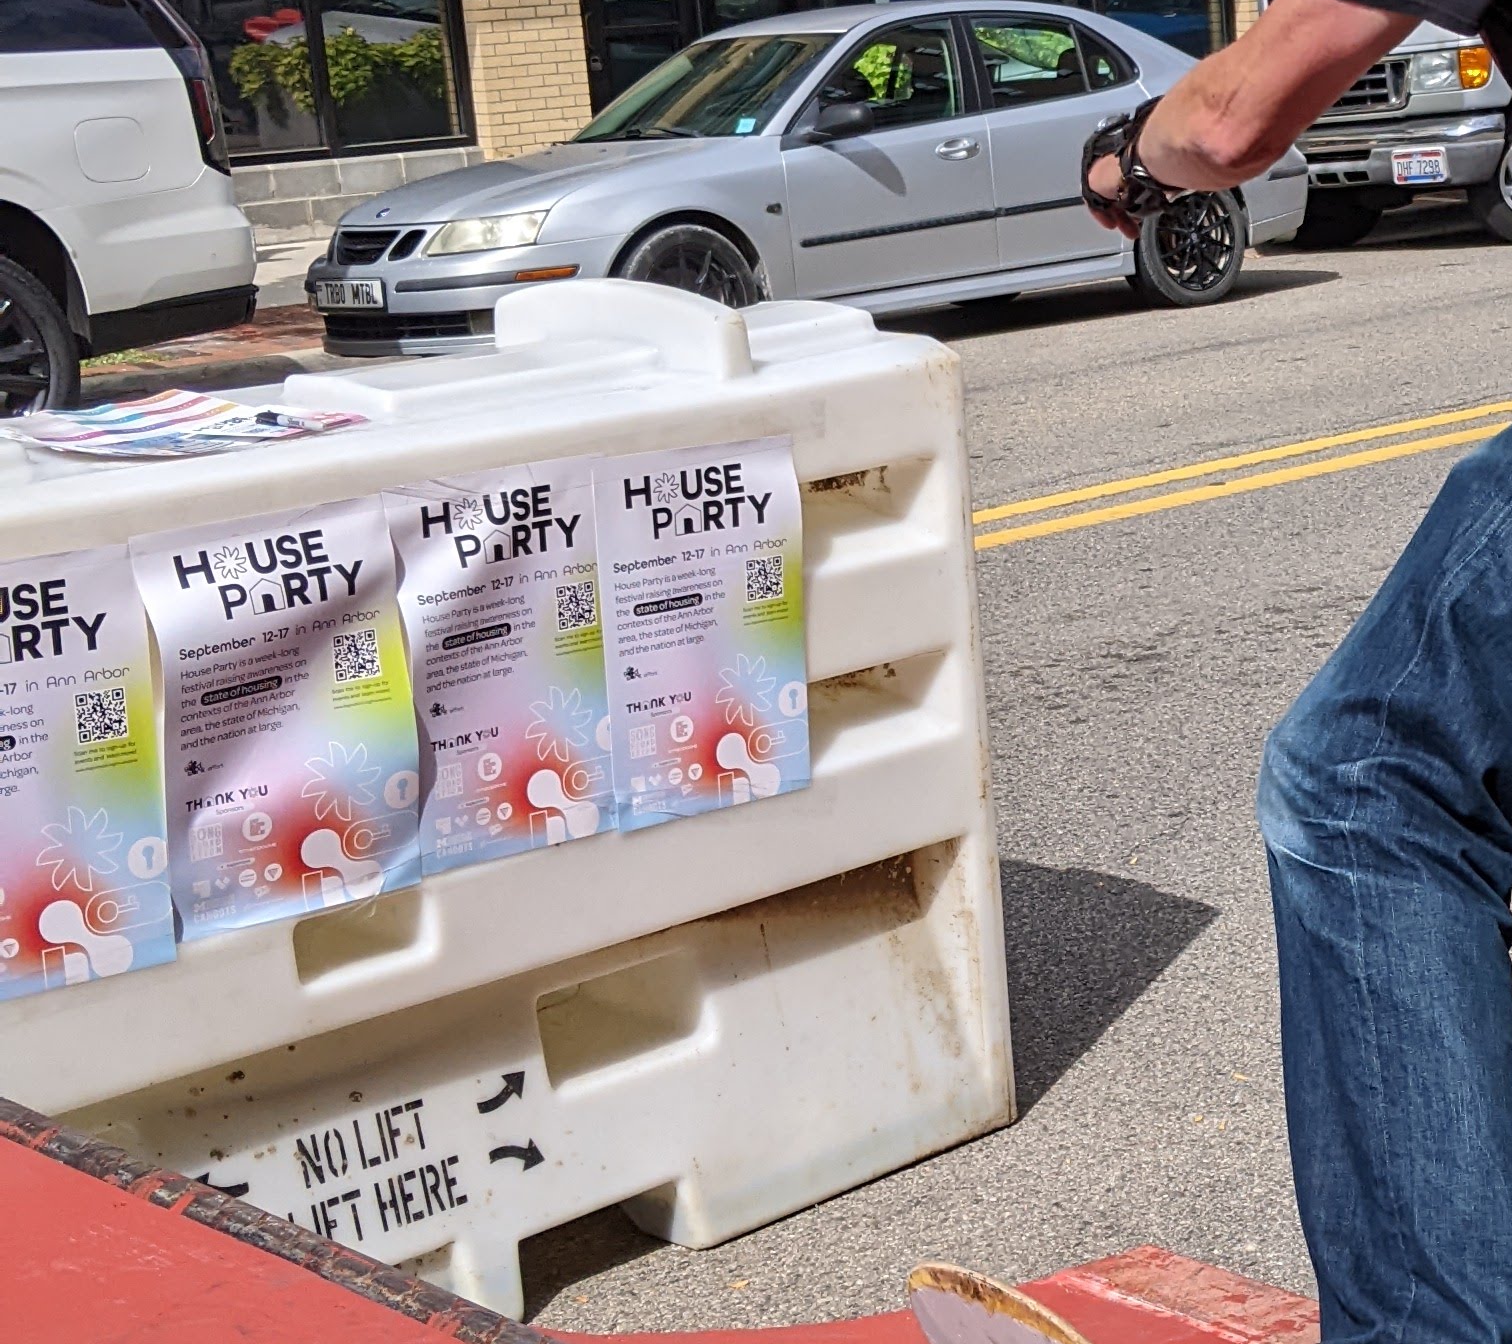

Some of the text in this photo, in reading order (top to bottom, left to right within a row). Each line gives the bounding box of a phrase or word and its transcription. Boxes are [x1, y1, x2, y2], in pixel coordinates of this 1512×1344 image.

[613, 538, 787, 574] September 12-17 in Ann Arbor
[417, 562, 597, 606] September 12-17 in Ann Arbor
[179, 609, 380, 661] September 12-17 in Ann Arbor
[25, 680, 38, 692] in
[46, 675, 76, 688] Ann
[84, 667, 130, 682] Arbor
[296, 1099, 426, 1189] NO LIFT
[374, 1156, 468, 1232] HERE
